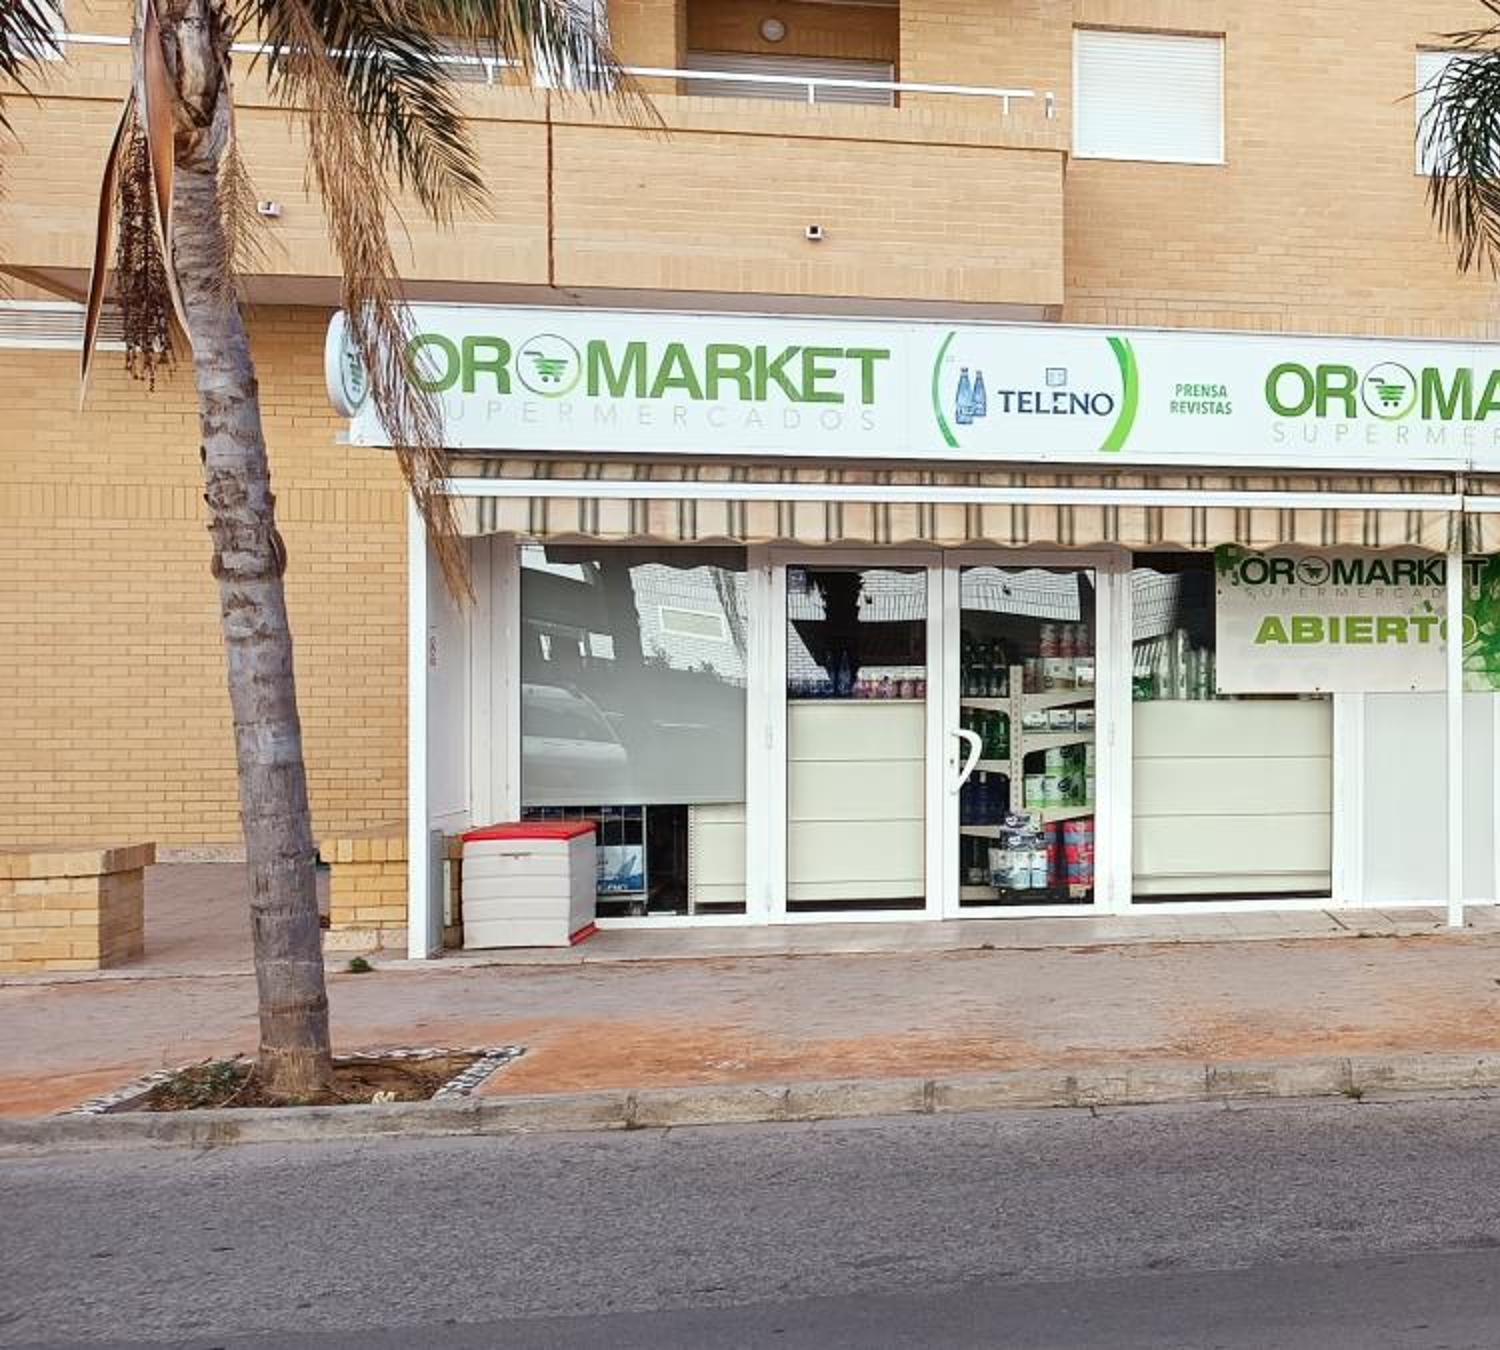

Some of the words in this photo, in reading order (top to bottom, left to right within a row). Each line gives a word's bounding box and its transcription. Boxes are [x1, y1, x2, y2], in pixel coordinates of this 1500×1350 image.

[997, 390, 1115, 417] TELENO
[1175, 383, 1228, 398] PRENSA
[447, 400, 876, 431] UPERMERCADOS
[1169, 400, 1233, 415] REVISTAS
[1239, 555, 1488, 587] OROMARKT
